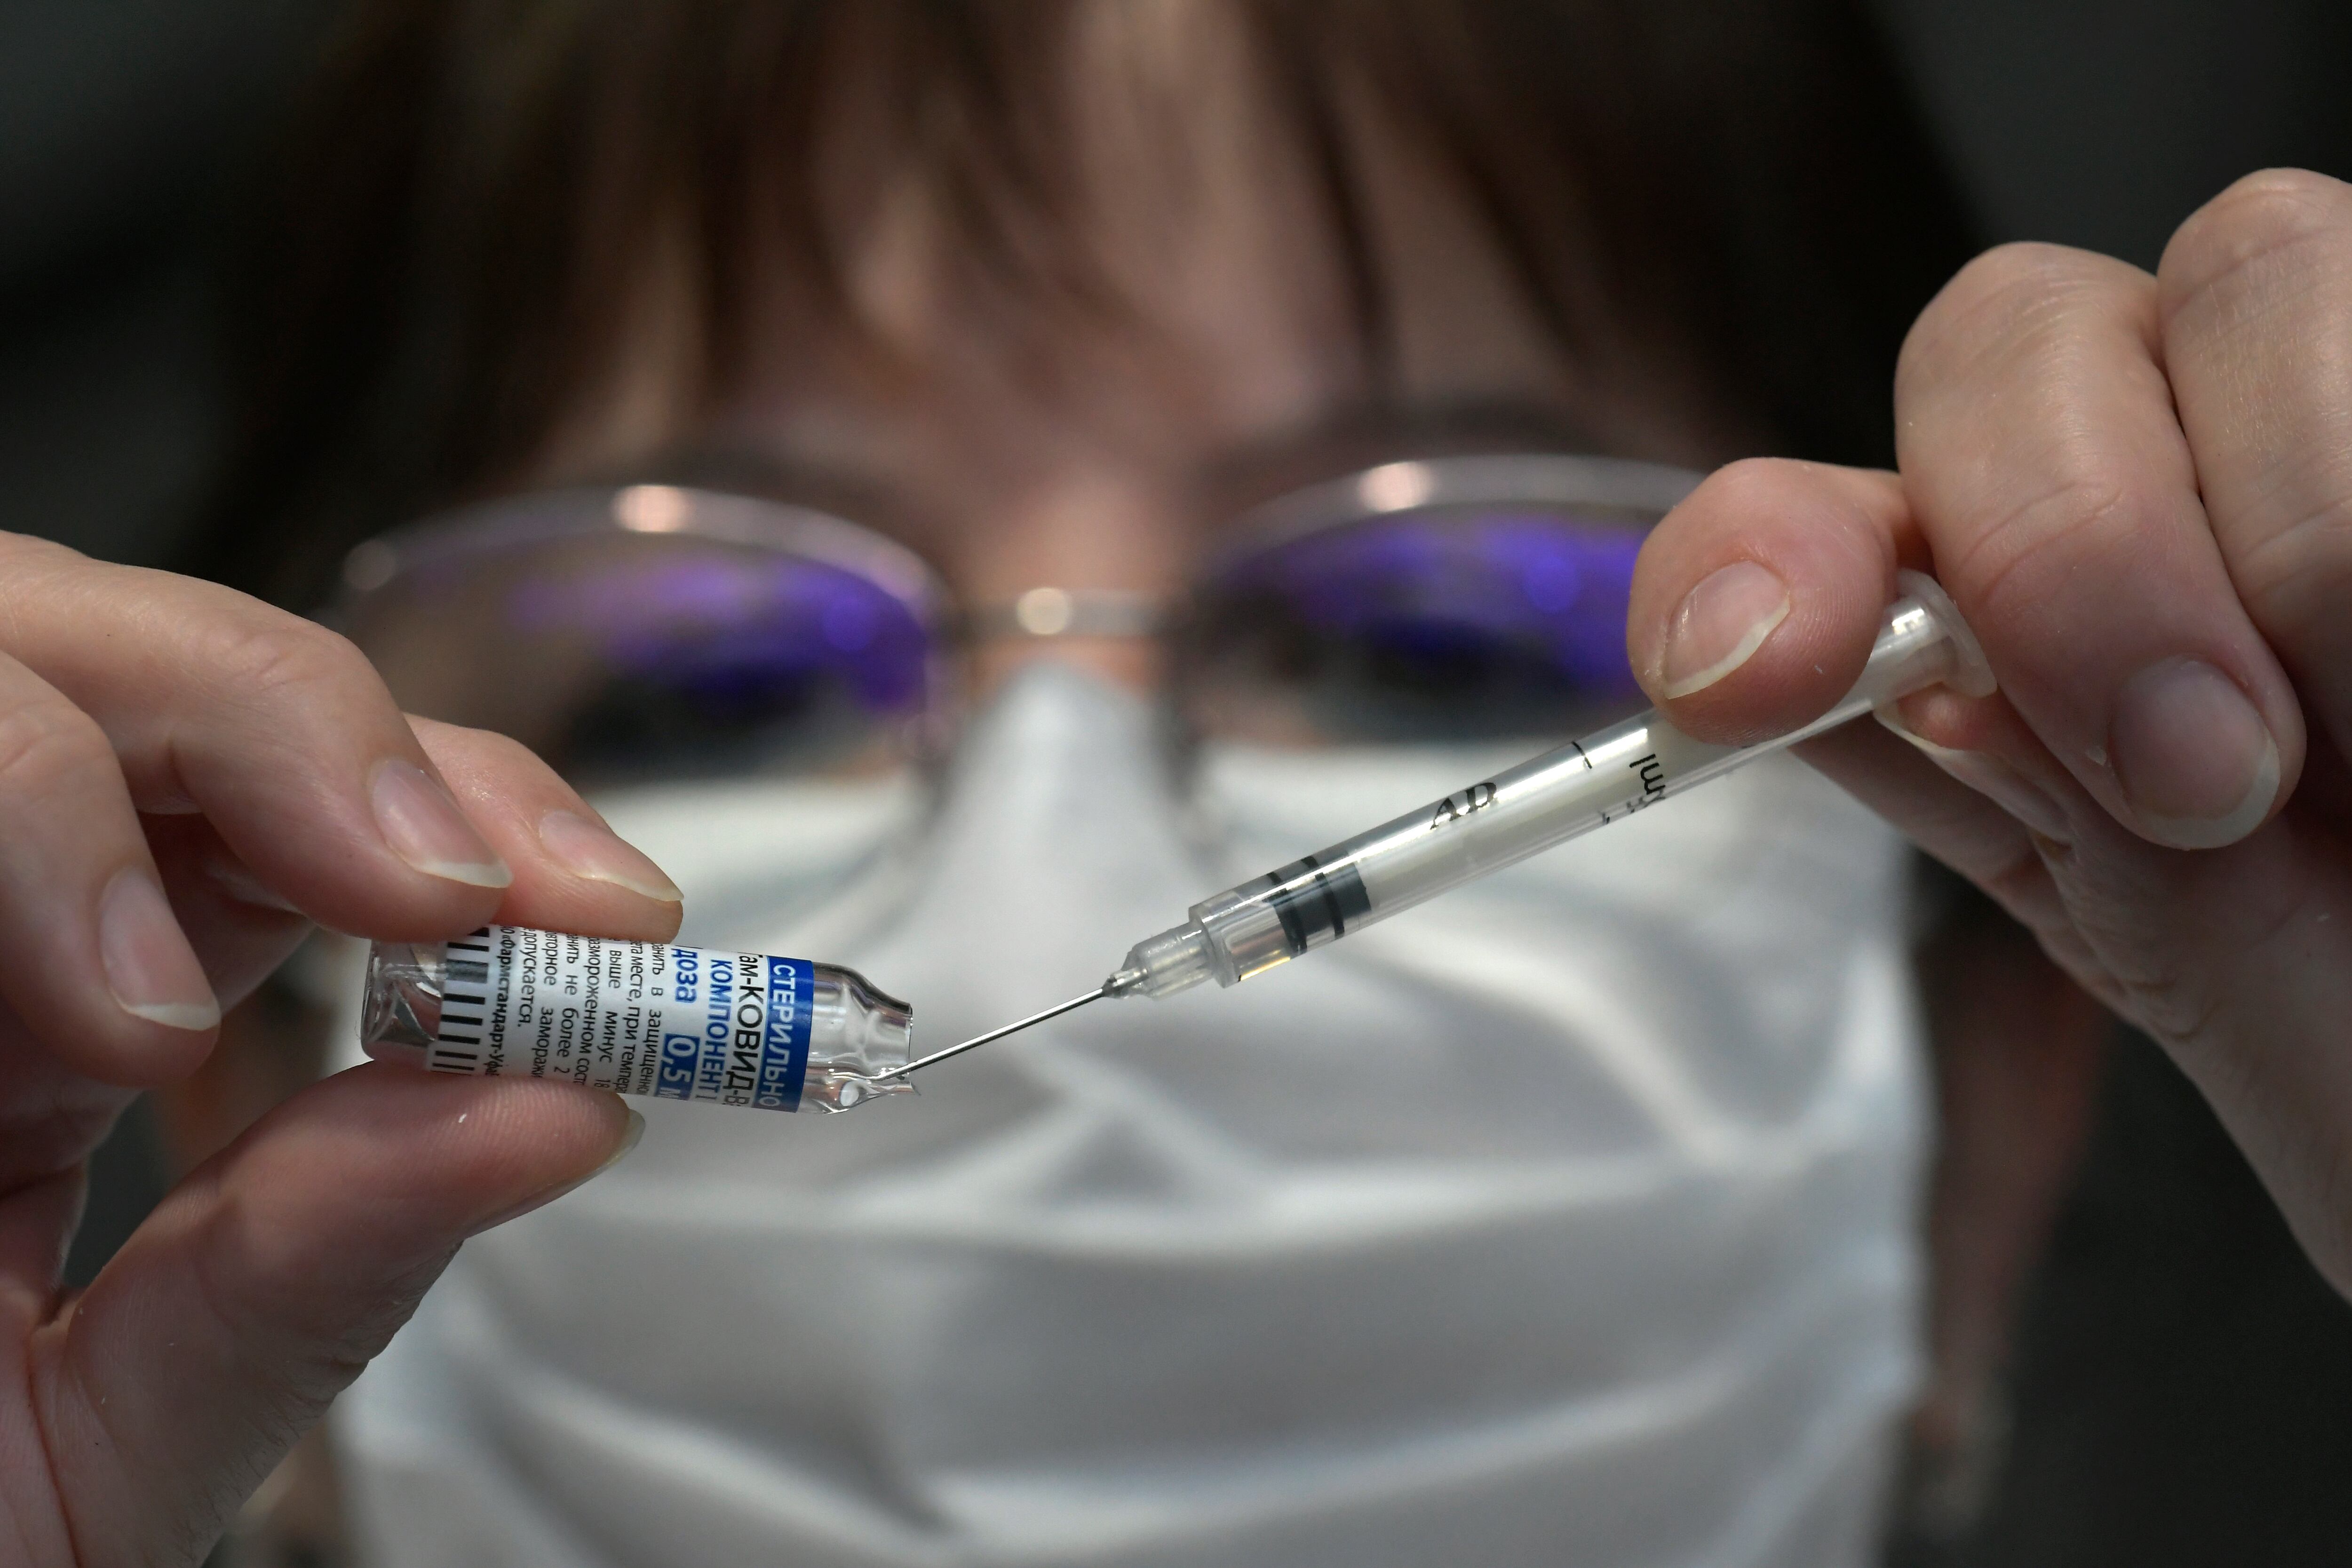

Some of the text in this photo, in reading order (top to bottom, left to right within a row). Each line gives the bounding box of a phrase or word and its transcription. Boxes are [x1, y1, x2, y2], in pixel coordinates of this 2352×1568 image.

[516, 931, 537, 1028] допускается.
[564, 975, 578, 995] не
[608, 950, 622, 989] выше
[625, 955, 643, 1002] месте,
[671, 948, 699, 1003] доза
[530, 930, 558, 1078] овторное заморажи
[621, 1006, 640, 1040] при
[635, 943, 665, 1096] ранить в защищенно
[698, 959, 733, 1093] КОМПОНЕНТ
[556, 1008, 579, 1058] более
[596, 1011, 618, 1063] минус
[758, 964, 795, 1106] СТЕРИЛЬНО
[572, 1058, 589, 1085] сост
[593, 1078, 611, 1088] 18
[612, 1044, 636, 1094] темпера
[660, 1037, 696, 1082] 0,5
